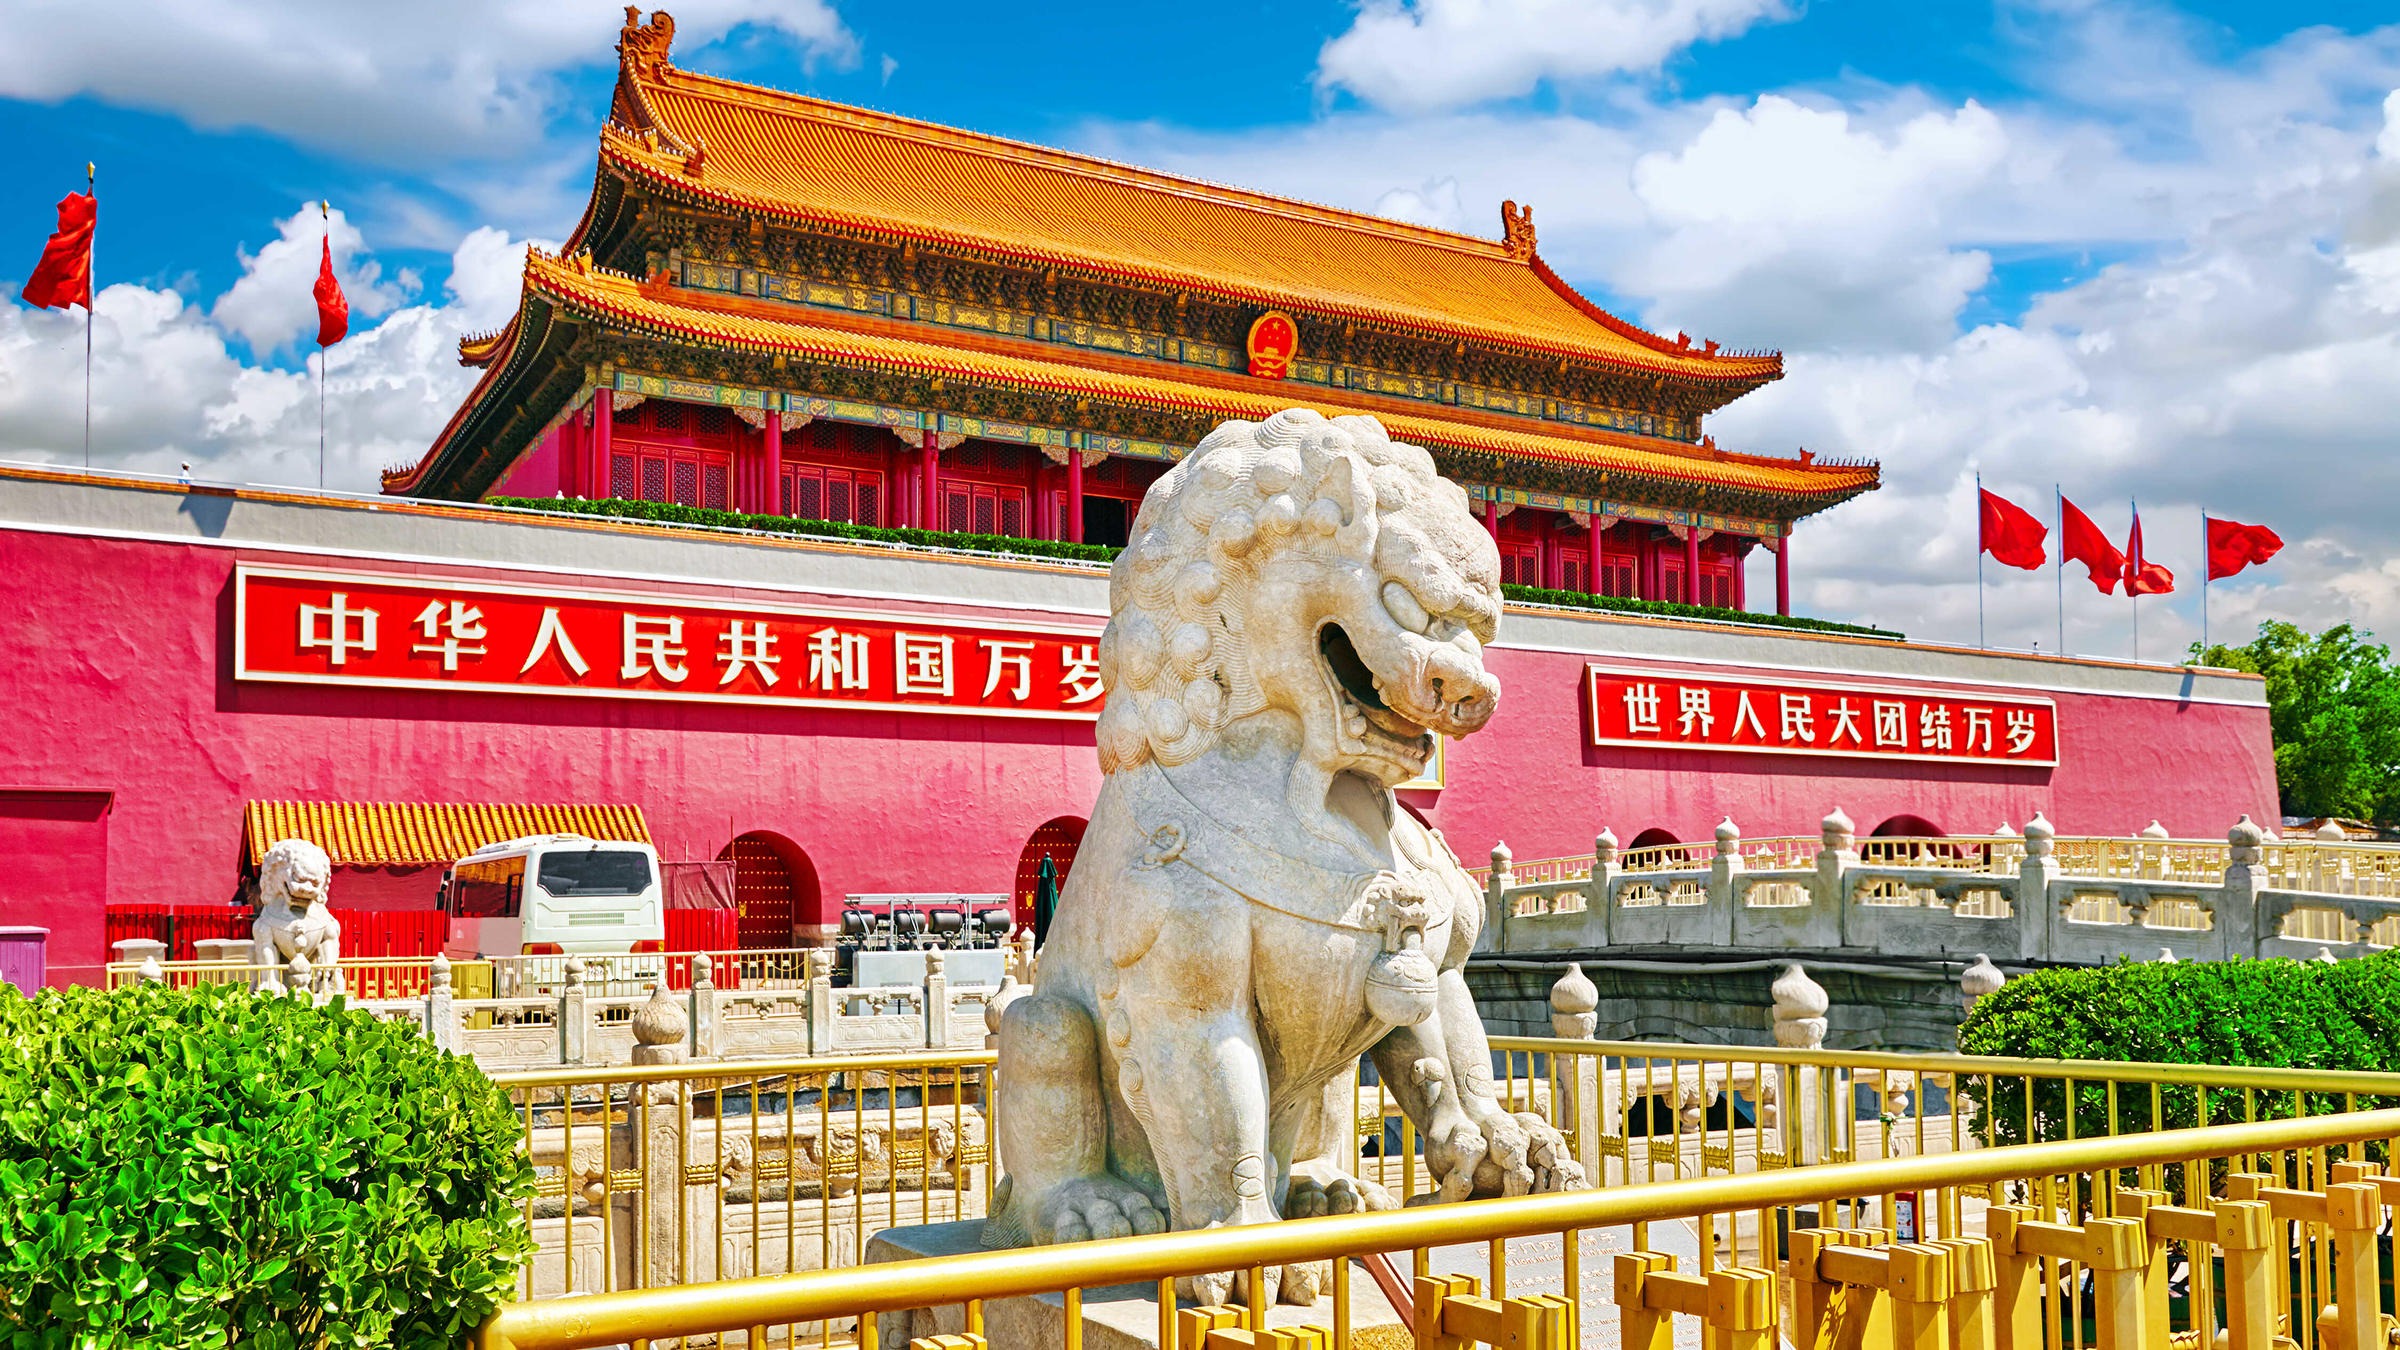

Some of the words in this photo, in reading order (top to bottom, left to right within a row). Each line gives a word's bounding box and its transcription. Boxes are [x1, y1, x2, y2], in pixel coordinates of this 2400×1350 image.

[298, 592, 1105, 704] 中华人民共和国万岁
[1622, 682, 2037, 754] 世界人民大团结万岁
